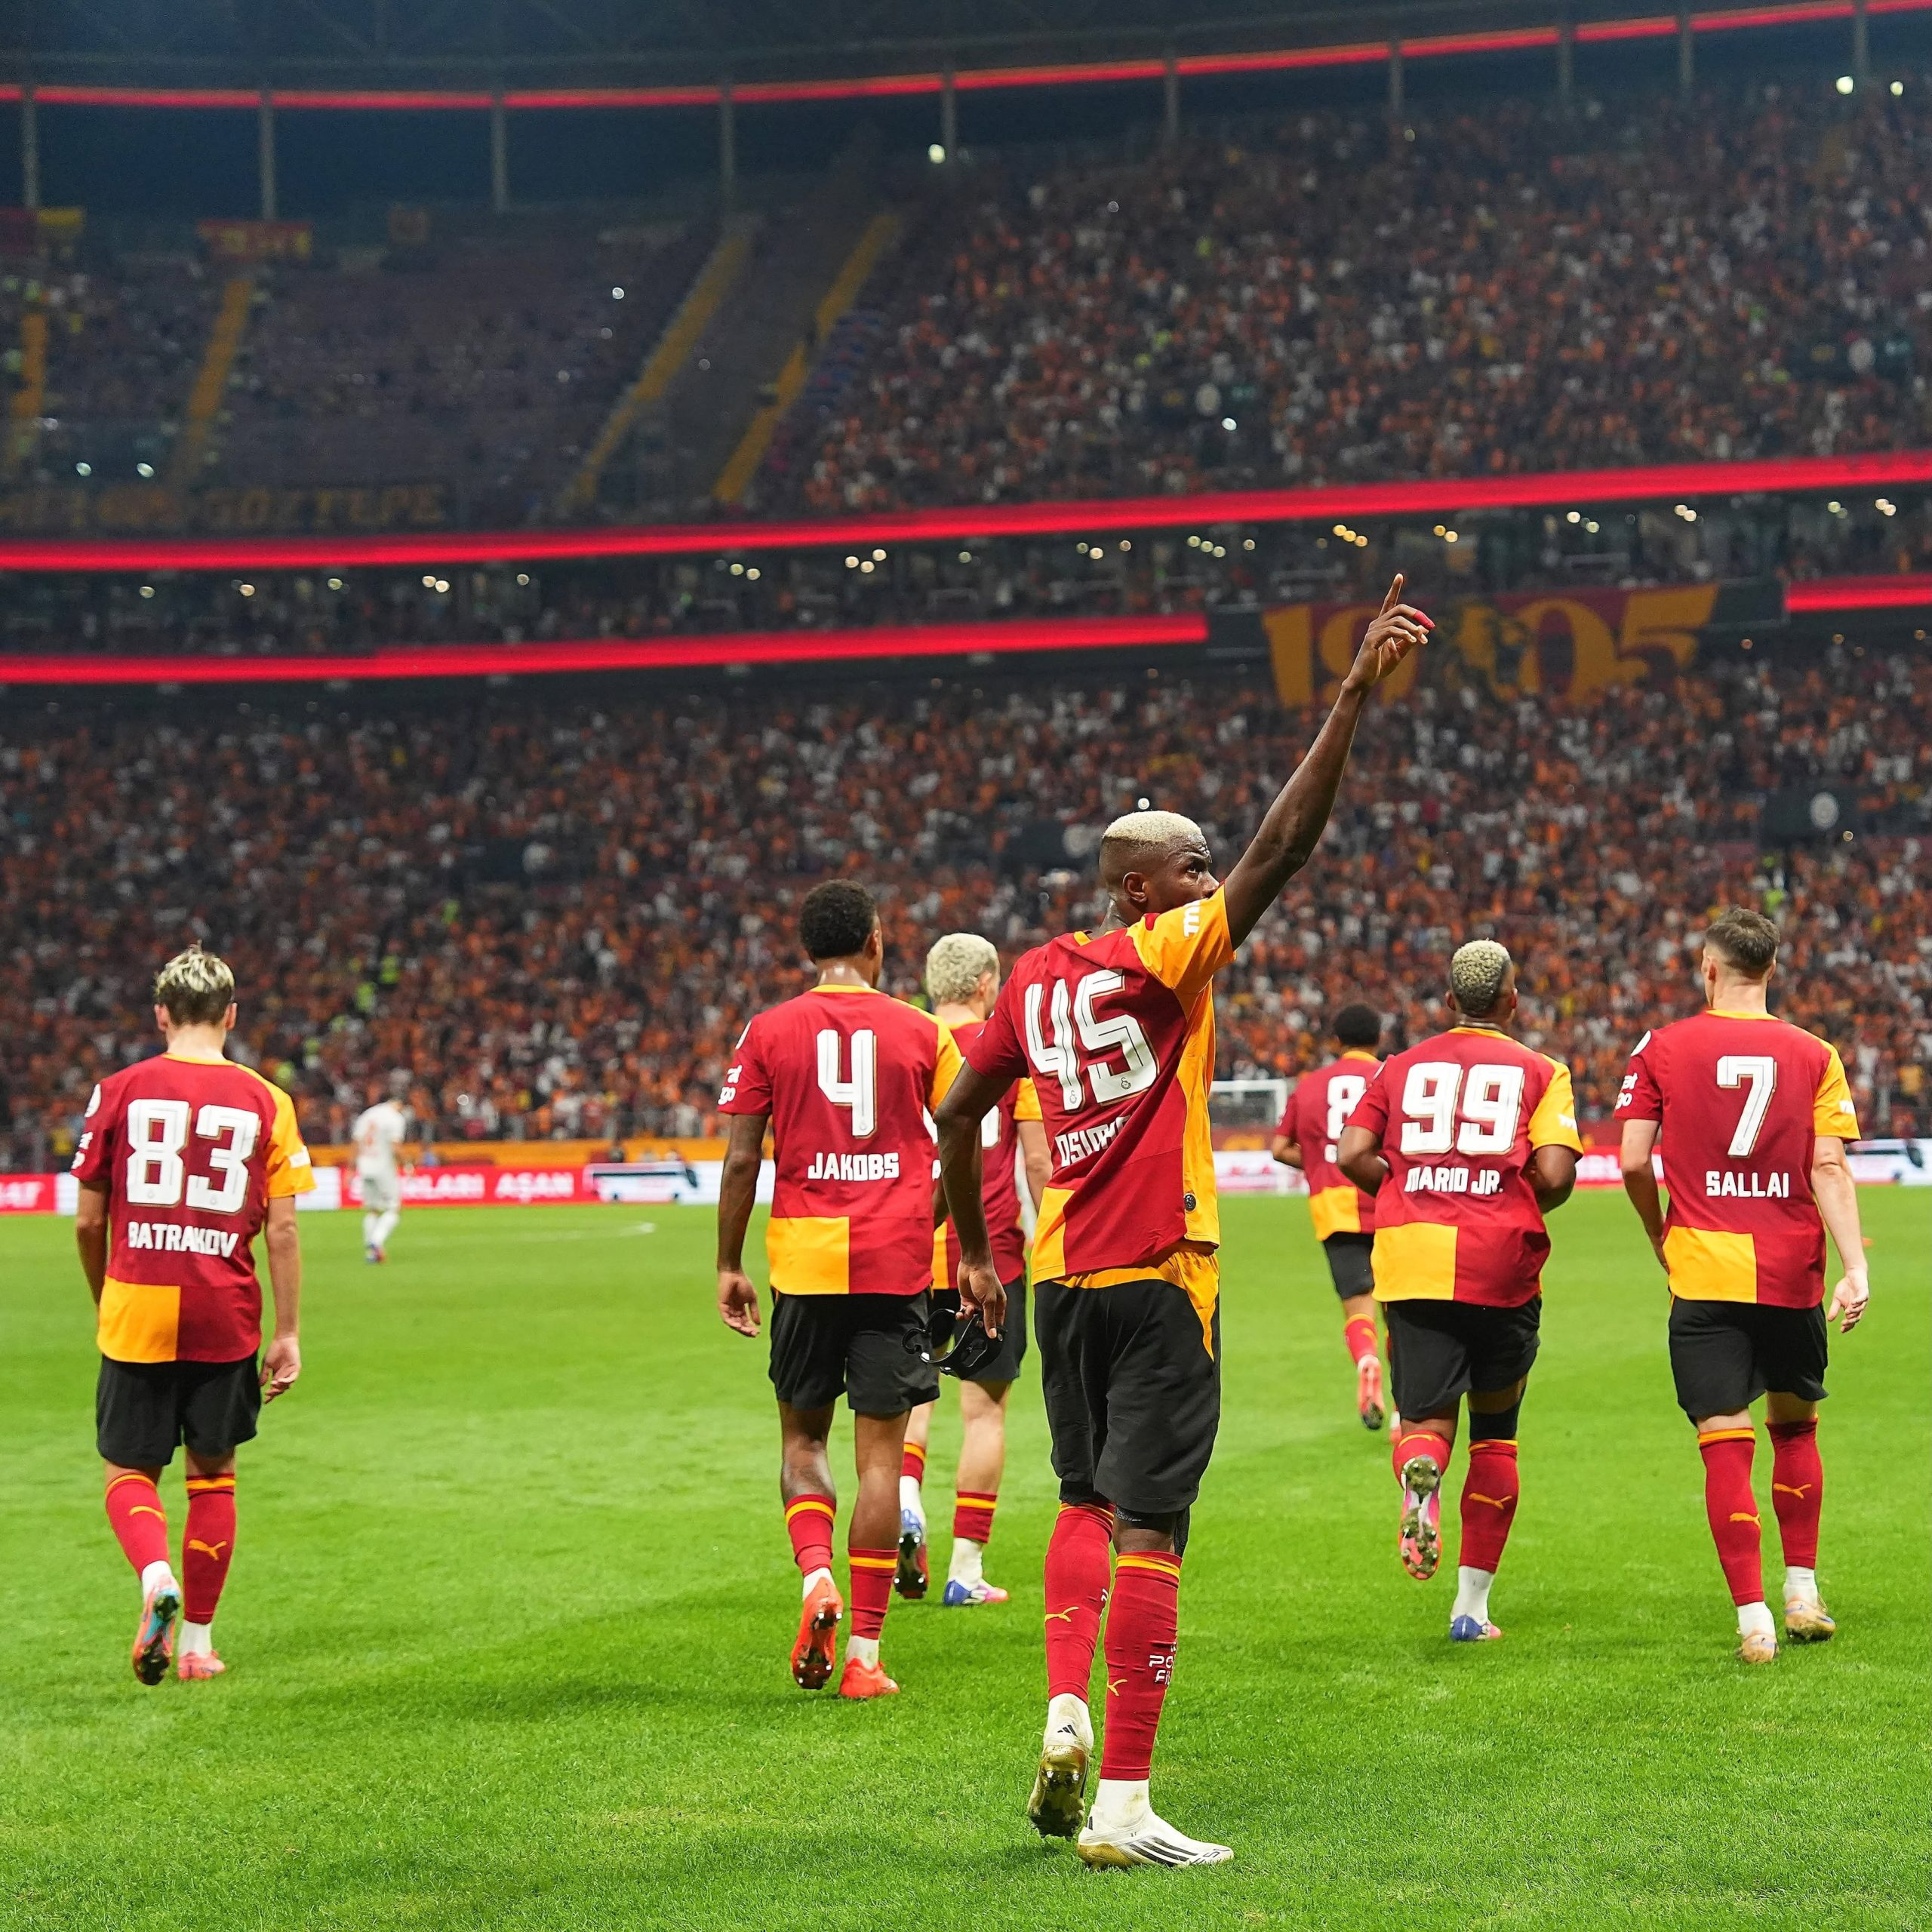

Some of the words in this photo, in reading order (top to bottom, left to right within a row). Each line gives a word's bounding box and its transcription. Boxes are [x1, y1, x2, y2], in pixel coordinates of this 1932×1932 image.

[1025, 969, 1160, 1112] 45
[817, 1029, 878, 1139] 4
[1400, 1061, 1526, 1155] 99
[1717, 1055, 1777, 1158] 7
[127, 1098, 262, 1216] 83
[494, 1172, 575, 1203] AŞAN
[808, 1152, 900, 1182] JAKOBS
[1404, 1166, 1469, 1192] MARIO
[1470, 1169, 1504, 1195] JR.
[1706, 1171, 1789, 1198] SALLAI
[128, 1221, 240, 1258] BATRAKOV
